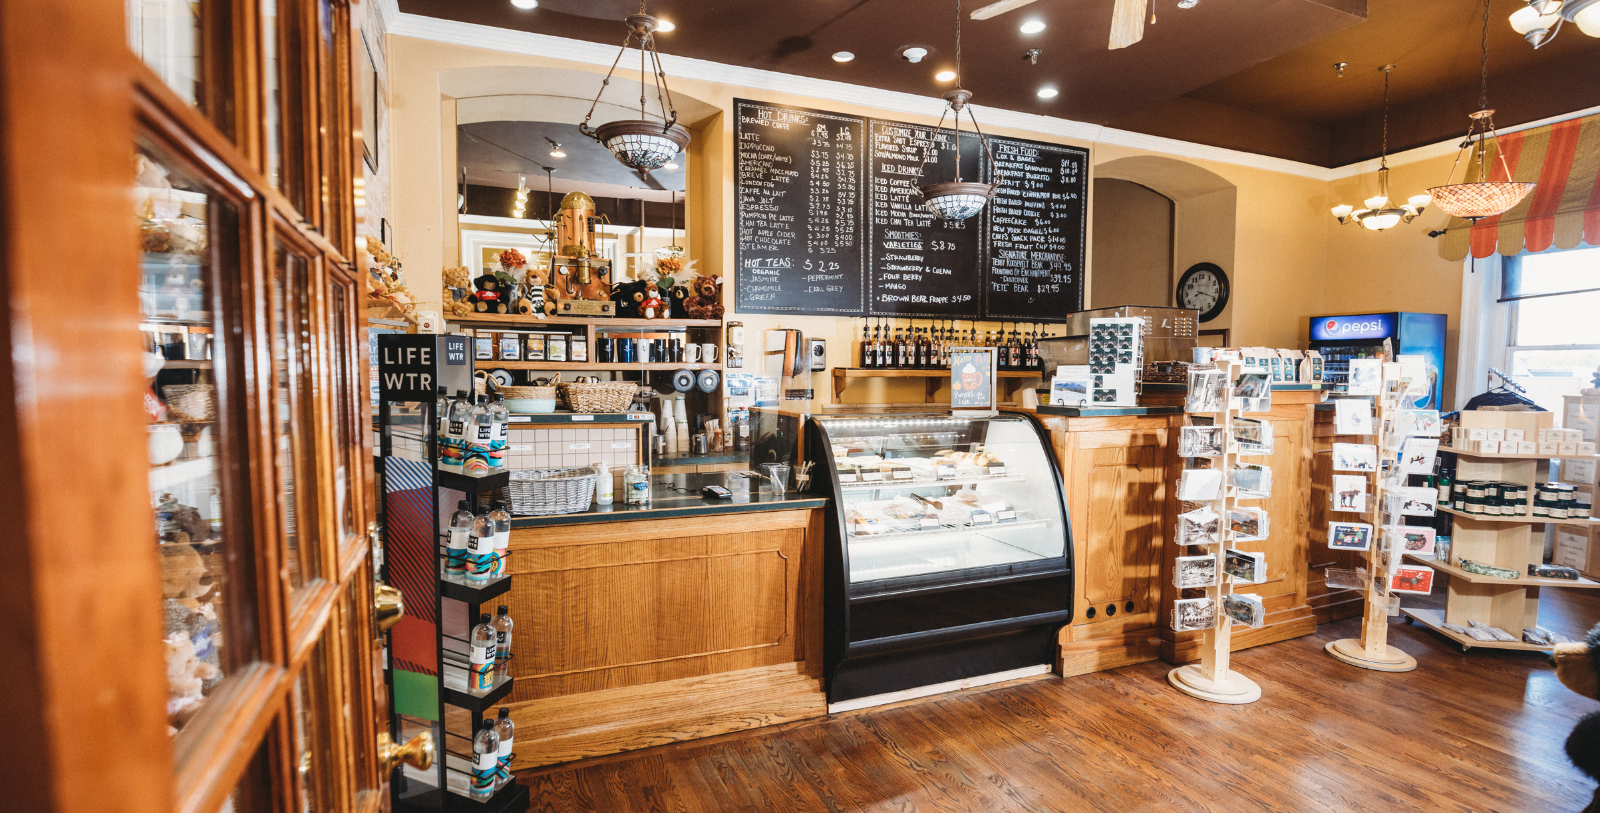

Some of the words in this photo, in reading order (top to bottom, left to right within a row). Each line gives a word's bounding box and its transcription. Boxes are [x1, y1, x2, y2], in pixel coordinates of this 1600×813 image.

[742, 116, 770, 126] BREWED
[758, 109, 773, 120] HOT
[777, 110, 809, 125] DRINKS:
[740, 133, 760, 141] LATTE
[875, 133, 891, 143] EXTRA
[875, 142, 899, 152] FLAVORED
[902, 145, 918, 155] SYRUP
[998, 143, 1019, 155] FRESH
[1020, 146, 1041, 158] FOOD:
[741, 166, 767, 174] CARAMEL
[881, 163, 896, 173] ICED
[994, 160, 1025, 170] BREAKFAST
[1025, 164, 1052, 174] SANDWICH
[741, 171, 763, 180] BREVE
[771, 176, 789, 184] LATTE
[1025, 172, 1050, 182] BURRITO
[741, 179, 762, 187] LONDON
[890, 178, 909, 187] COFFEE
[993, 195, 1007, 204] FRESH
[741, 204, 778, 212] ESPRESSO
[890, 202, 911, 211] VANILLA
[993, 205, 1007, 214] FRESH
[741, 211, 766, 220] PUMPKIN
[741, 228, 753, 236] HOT
[777, 231, 795, 240] CIDER
[885, 229, 921, 240] SMOOTHIES:
[1006, 227, 1021, 235] YORK
[754, 236, 791, 246] CHOCOLATE
[883, 241, 923, 250] VARIETIES
[1036, 242, 1048, 250] CUP
[741, 243, 779, 251] STEAMER
[998, 249, 1027, 260] SIGNATURE
[745, 258, 763, 268] HOT
[766, 258, 794, 268] TEAS:
[1007, 259, 1029, 269] ROOSEVELT
[1032, 260, 1043, 269] BEAR
[752, 269, 780, 277] ORGANIC
[933, 267, 951, 275] CREAM
[1014, 284, 1028, 292] BEAR
[881, 294, 909, 302] BROWN
[912, 295, 928, 303] BEAR
[1342, 319, 1382, 335] pepsi
[385, 348, 430, 364] LIFE
[953, 355, 972, 367] Hello
[975, 355, 990, 366] Fall
[385, 373, 431, 390] WTR
